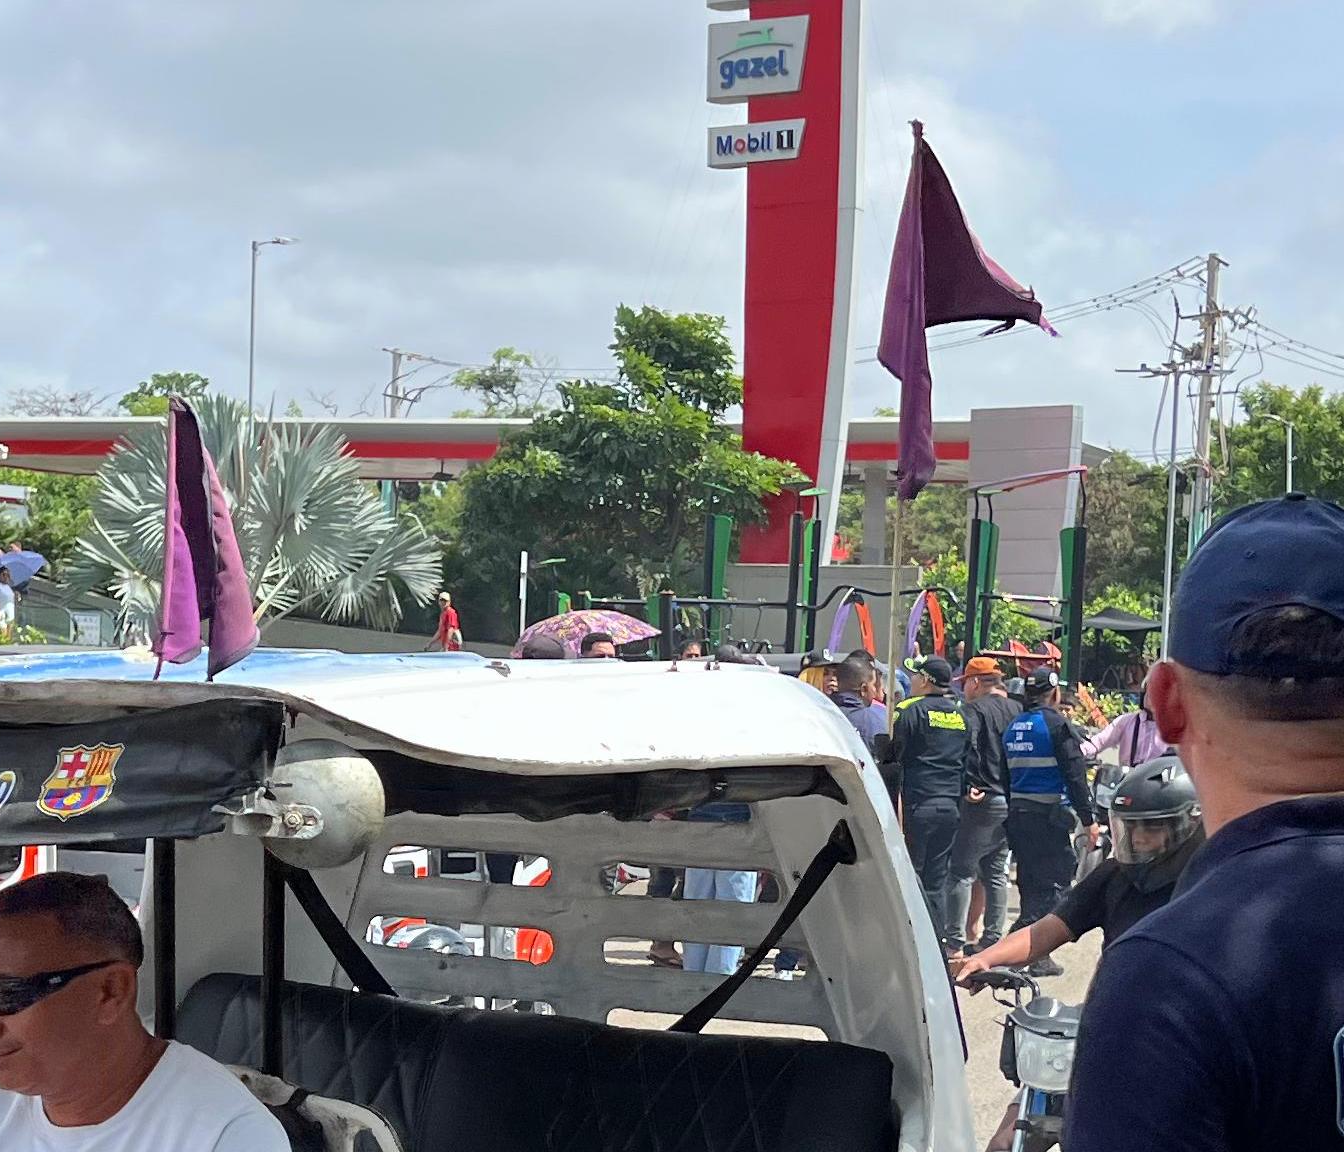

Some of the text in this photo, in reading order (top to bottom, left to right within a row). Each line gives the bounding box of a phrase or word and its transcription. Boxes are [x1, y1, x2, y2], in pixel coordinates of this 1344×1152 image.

[719, 49, 789, 89] gazel
[716, 129, 794, 156] Mobil 1
